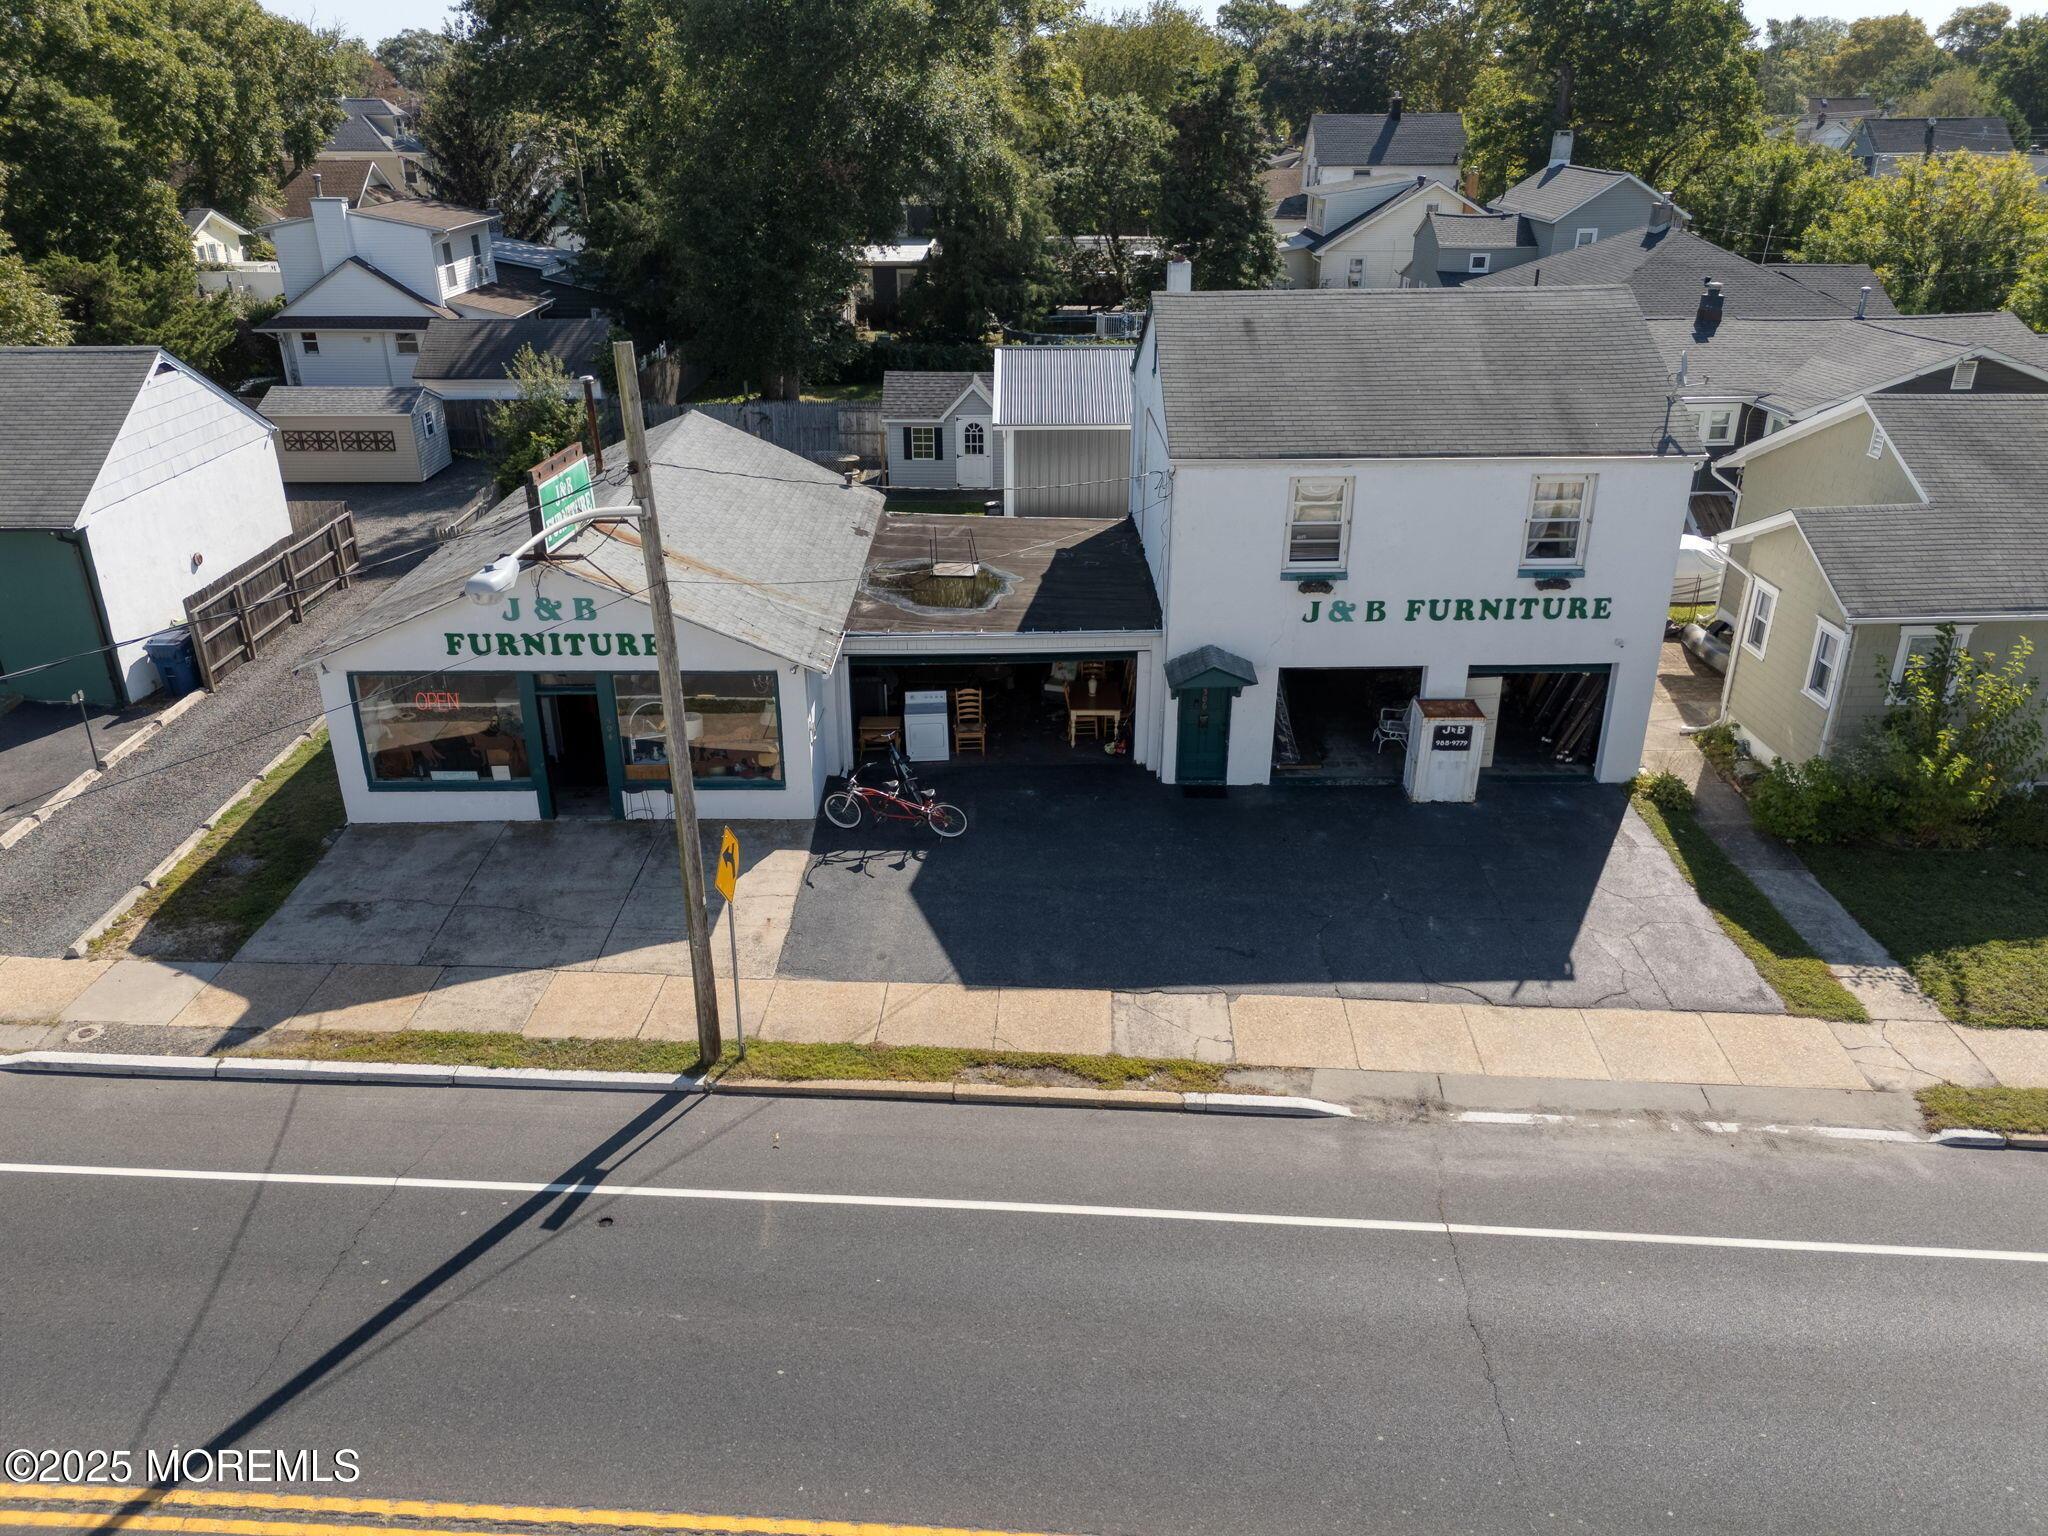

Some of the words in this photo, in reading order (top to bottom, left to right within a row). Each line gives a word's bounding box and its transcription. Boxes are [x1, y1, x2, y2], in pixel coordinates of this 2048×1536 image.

[502, 597, 520, 621] J
[534, 597, 563, 621] &
[572, 598, 598, 621] B
[1302, 601, 1322, 623] J
[1328, 600, 1356, 623] &
[1364, 600, 1387, 623] B
[1404, 597, 1612, 622] FURNITURE
[444, 632, 658, 656] FURNITURE
[415, 691, 460, 712] OPEN
